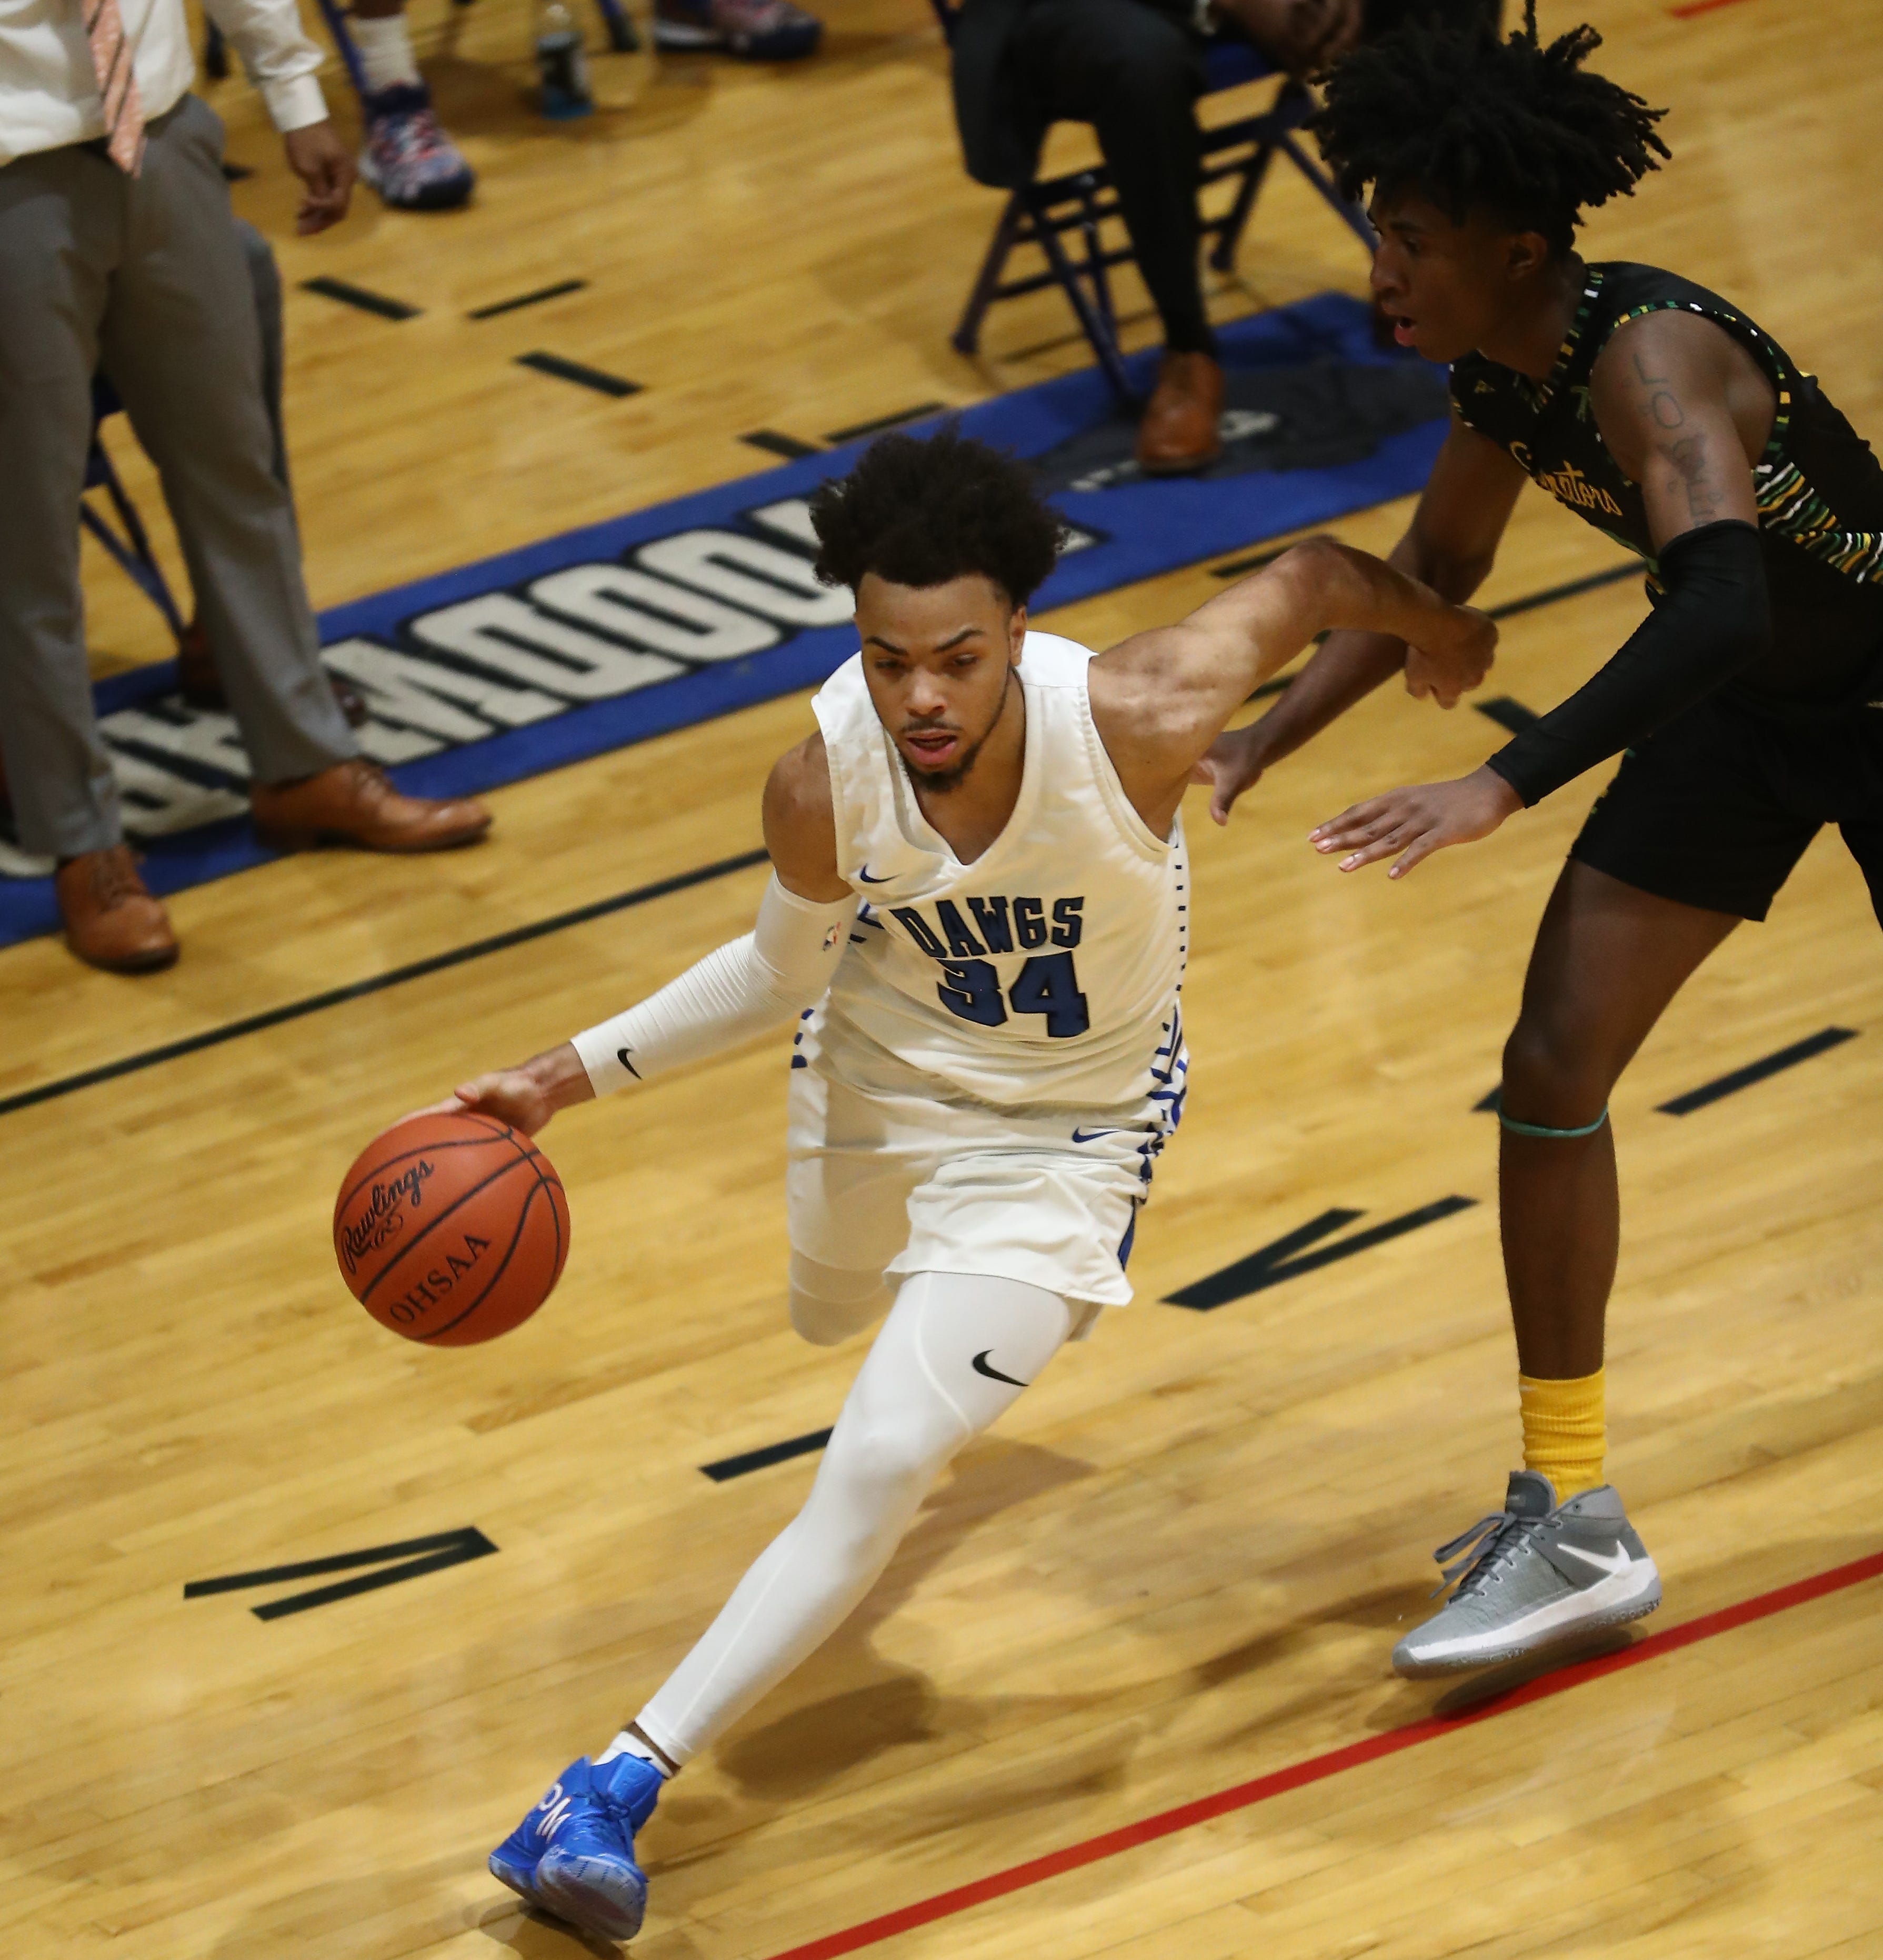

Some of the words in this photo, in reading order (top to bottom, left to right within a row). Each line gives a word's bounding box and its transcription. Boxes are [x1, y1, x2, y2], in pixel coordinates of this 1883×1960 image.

[889, 896, 1084, 958] DAWGS
[936, 951, 1090, 1038] 34
[342, 1159, 434, 1275] Rawlings
[389, 1234, 490, 1324] OHSAA
